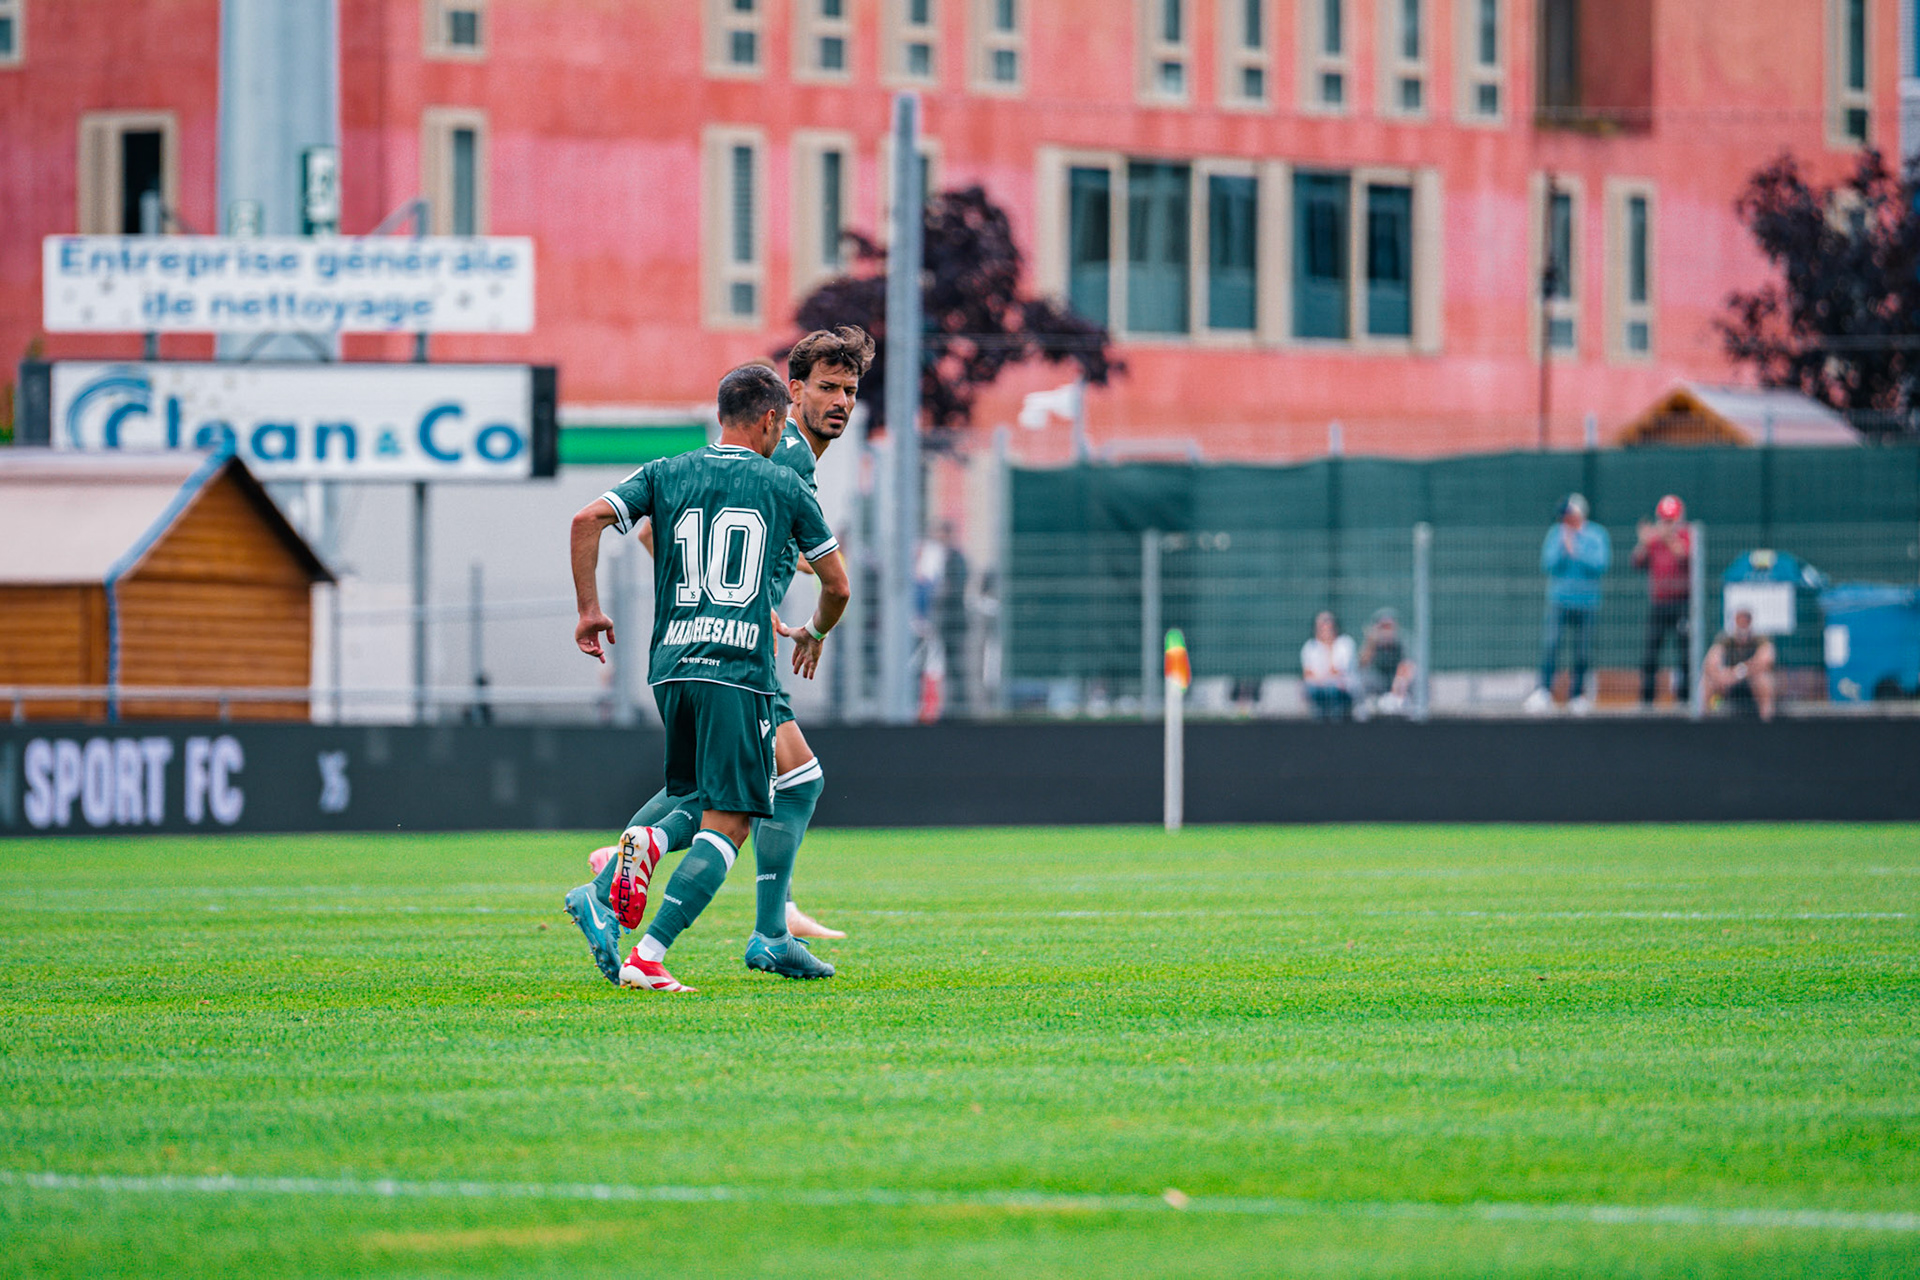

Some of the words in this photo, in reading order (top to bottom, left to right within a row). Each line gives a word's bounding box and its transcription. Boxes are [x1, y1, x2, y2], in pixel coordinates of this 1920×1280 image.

[60, 241, 298, 280] Entreprise
[143, 290, 195, 320] de
[210, 291, 433, 326] nettoyage
[419, 402, 525, 464] Co
[674, 507, 767, 607] 10
[24, 737, 174, 829] SPORT
[184, 734, 245, 826] FC
[618, 832, 636, 924] PREDATOR
